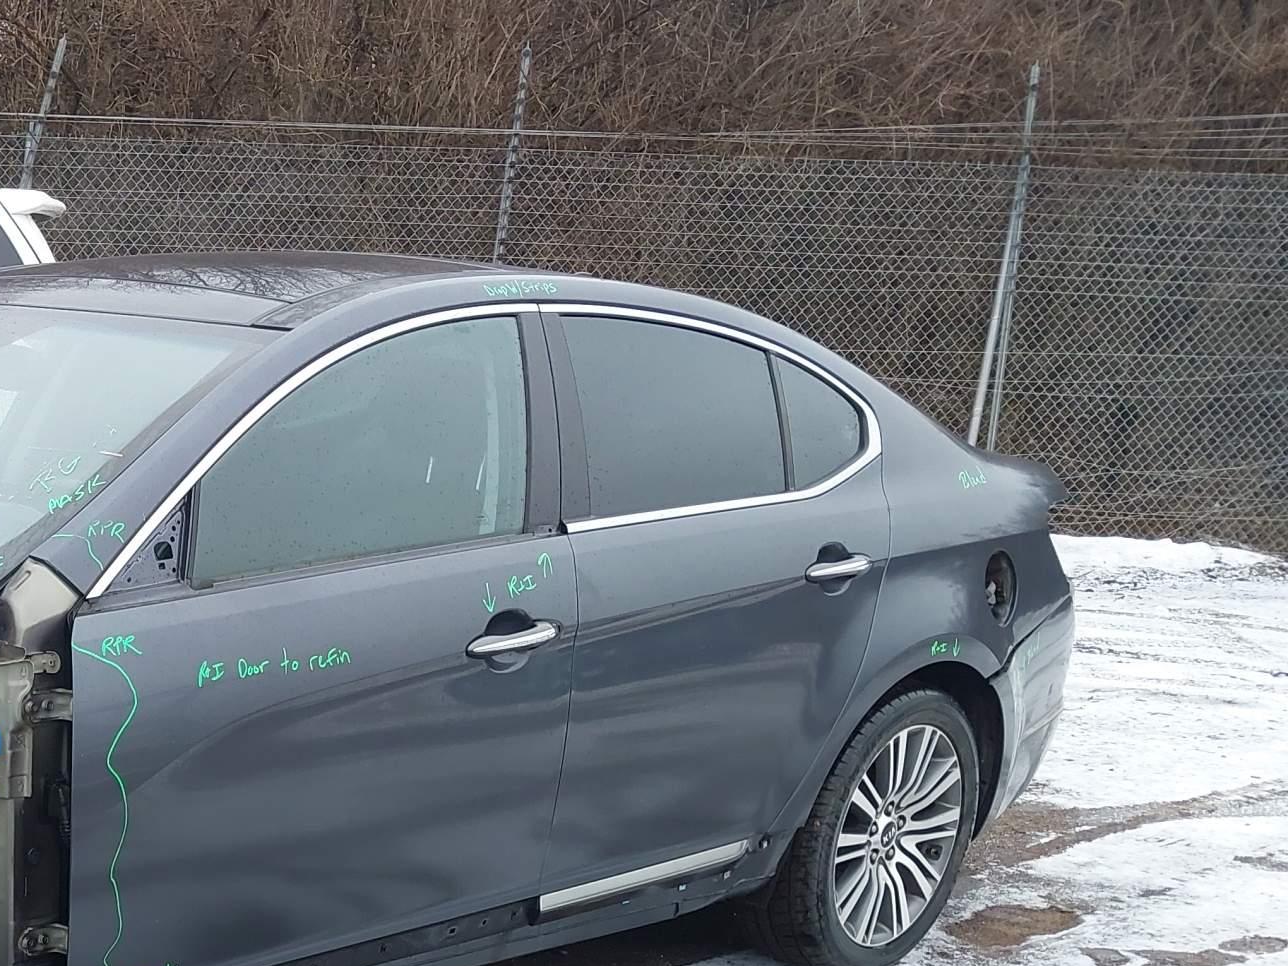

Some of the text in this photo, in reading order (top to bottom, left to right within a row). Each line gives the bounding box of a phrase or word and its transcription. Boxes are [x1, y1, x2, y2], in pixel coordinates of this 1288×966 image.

[101, 634, 143, 657] RPR
[238, 658, 270, 679] Door
[280, 647, 300, 675] to
[882, 826, 896, 846] KIA
